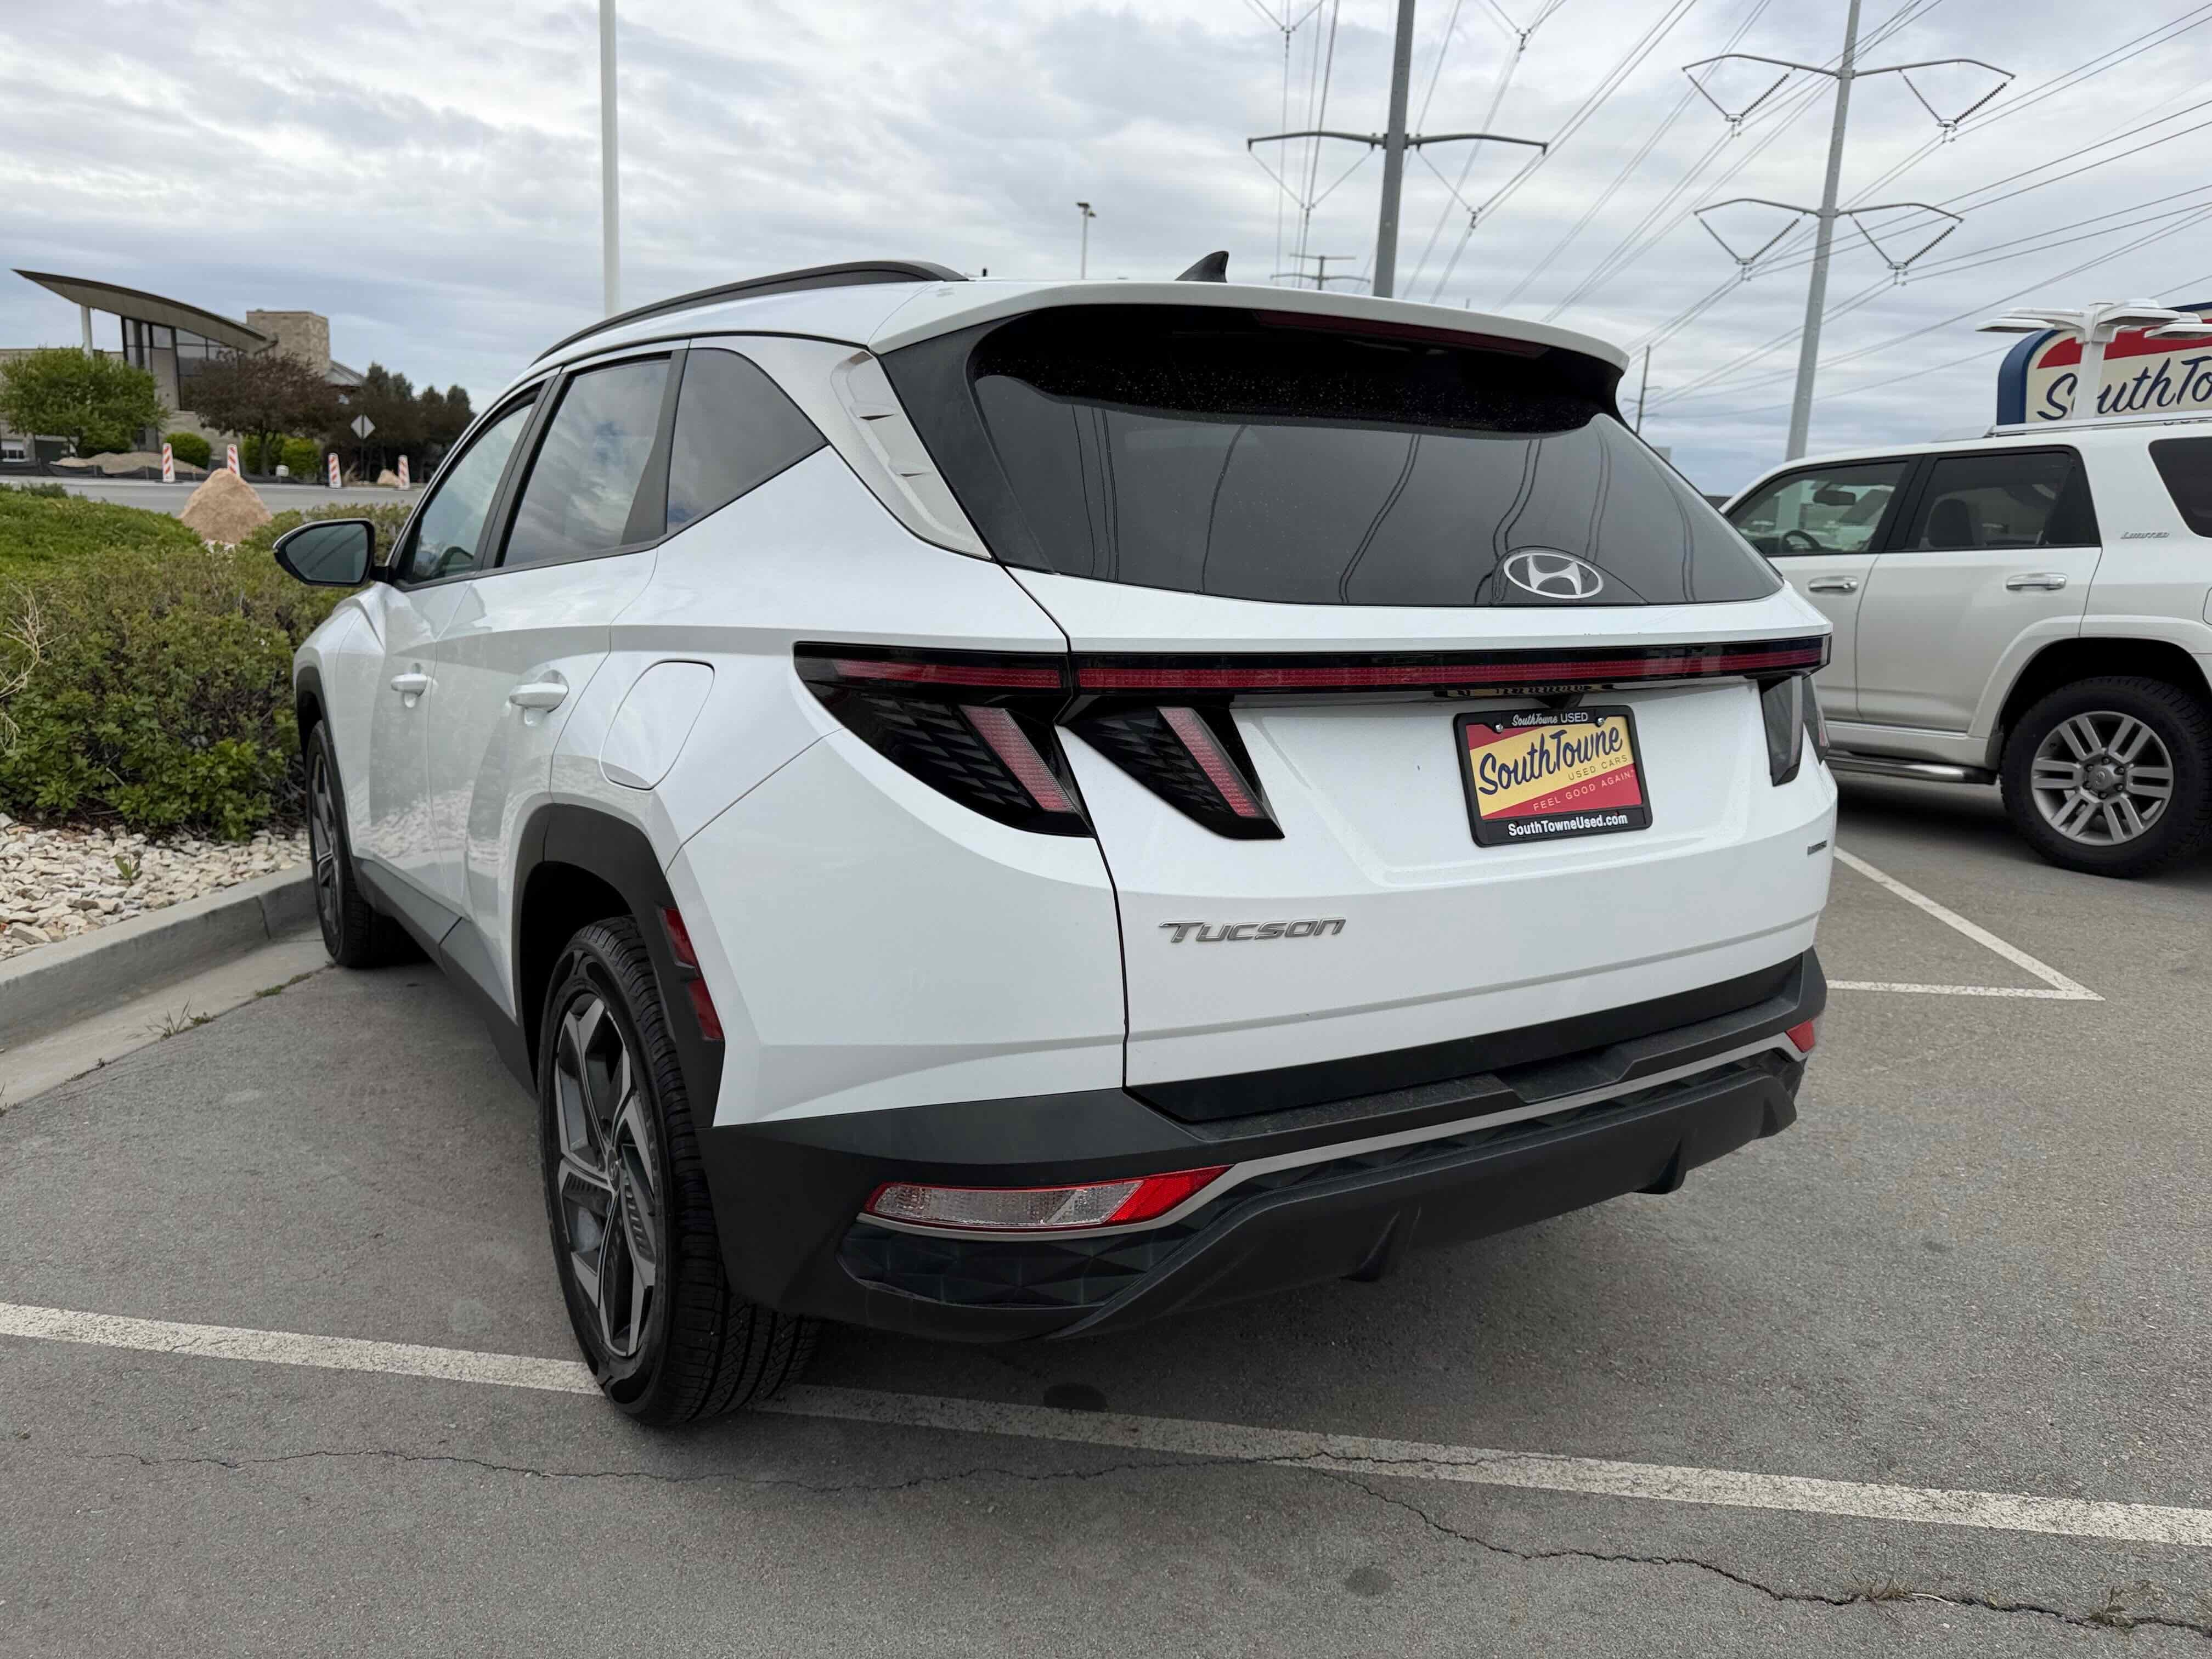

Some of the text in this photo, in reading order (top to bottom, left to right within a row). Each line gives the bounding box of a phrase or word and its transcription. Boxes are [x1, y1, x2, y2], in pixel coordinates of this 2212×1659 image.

[2036, 356, 2212, 420] SuthTo
[1511, 712, 1588, 726] SouthTowne USED
[1479, 726, 1623, 795] SouthTowne
[1568, 755, 1628, 781] USED CARS
[1533, 797, 1561, 811] FEEL
[1565, 783, 1595, 800] GOOD
[1508, 813, 1628, 837] SouthTowneUsed.com
